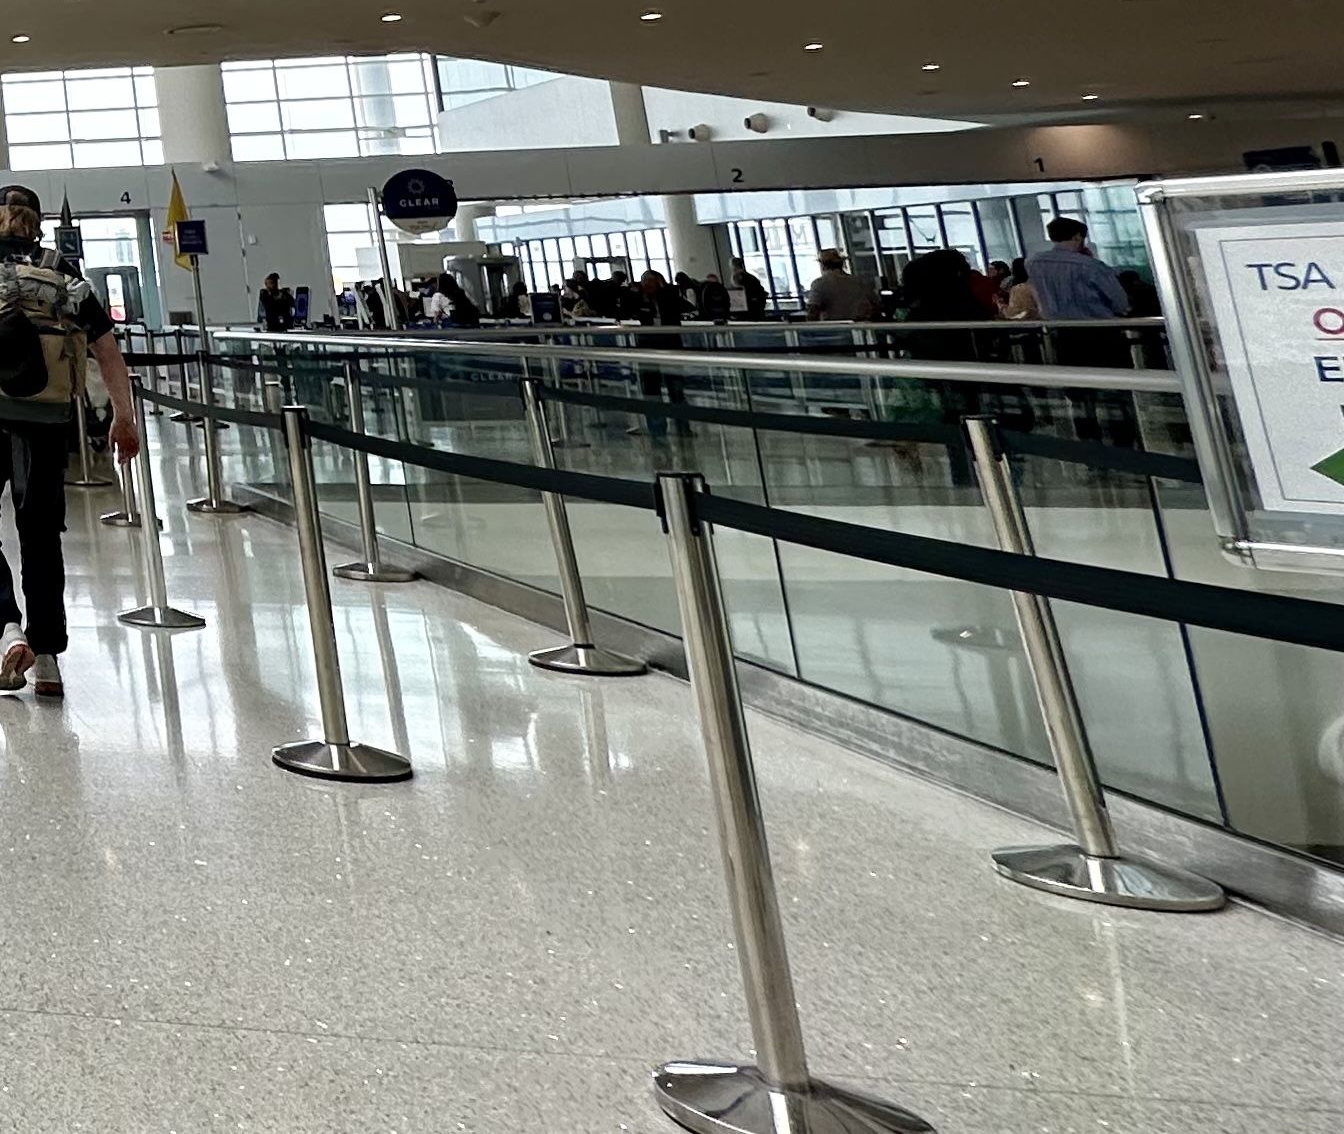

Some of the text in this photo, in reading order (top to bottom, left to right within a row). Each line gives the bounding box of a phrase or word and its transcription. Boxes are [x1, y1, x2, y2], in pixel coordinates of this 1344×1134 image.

[1033, 158, 1044, 172] 1
[731, 168, 744, 183] 2
[120, 191, 132, 205] 4
[399, 197, 440, 208] CLEAR
[1245, 262, 1337, 291] TSA
[1314, 356, 1344, 382] E
